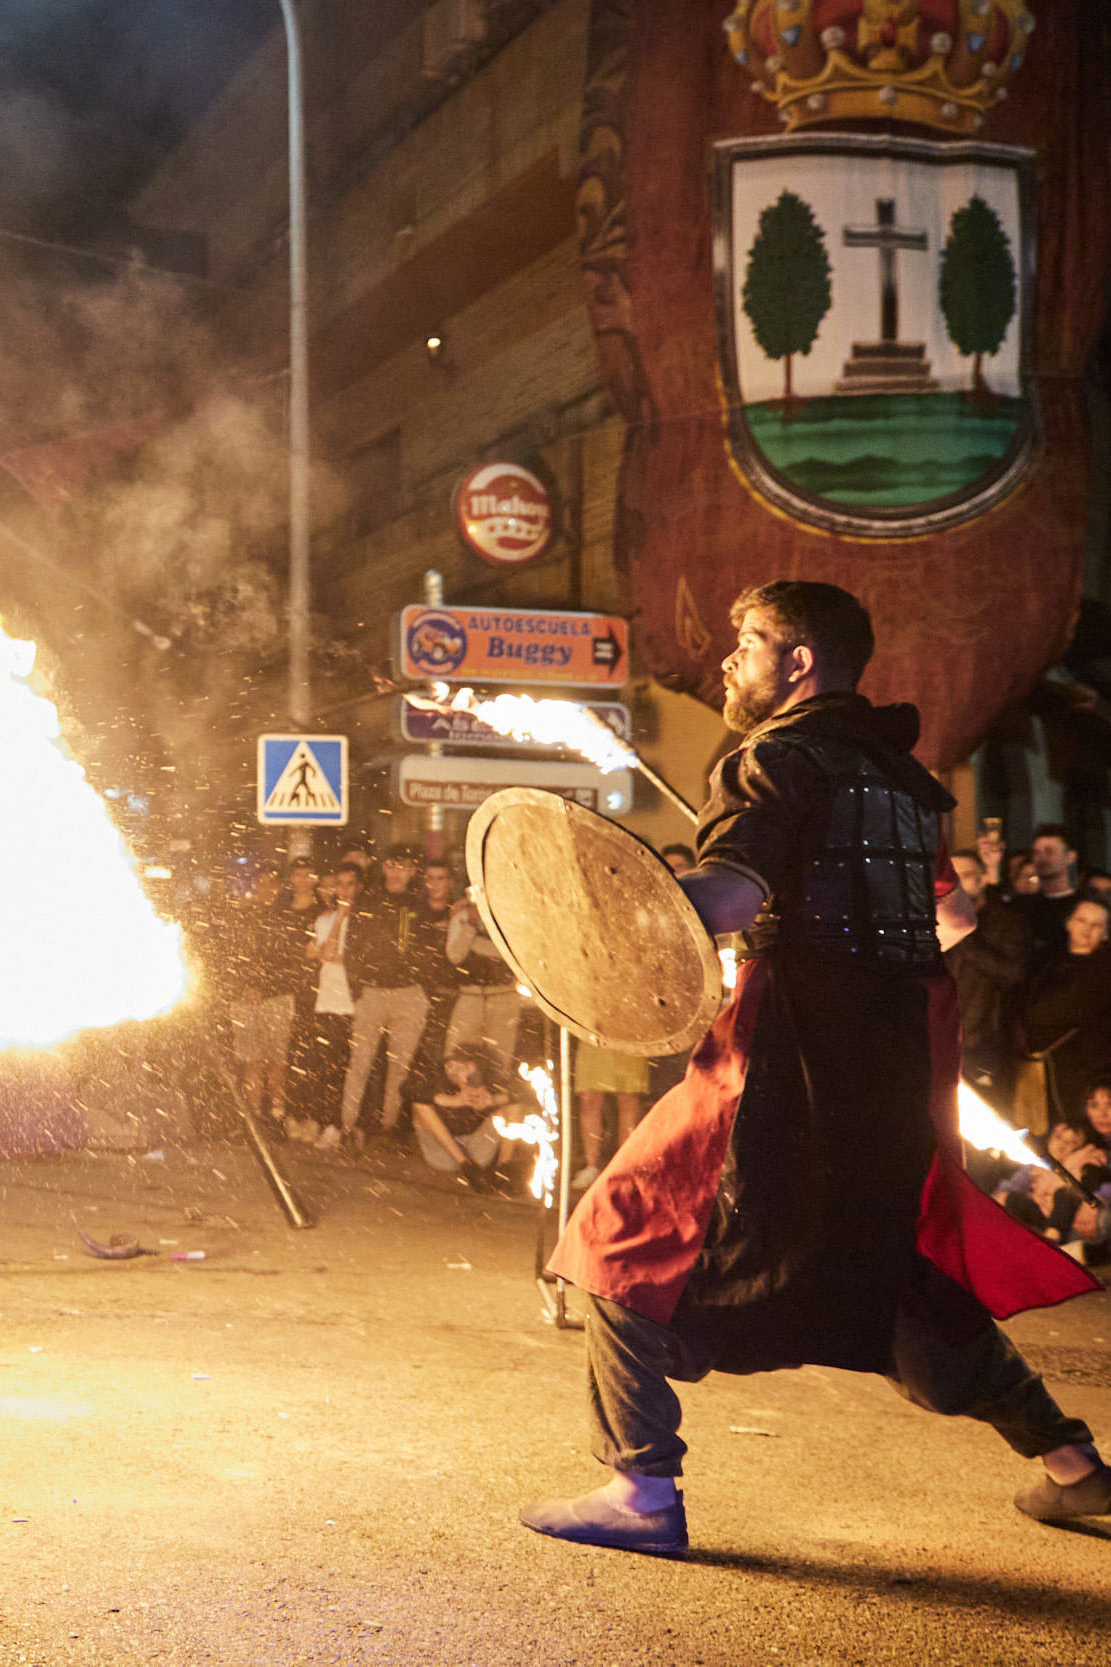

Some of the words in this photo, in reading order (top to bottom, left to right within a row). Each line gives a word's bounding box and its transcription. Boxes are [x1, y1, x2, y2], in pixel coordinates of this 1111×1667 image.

[469, 616, 591, 636] AUTOESCUELA
[486, 636, 573, 666] Buggy
[409, 783, 441, 800] Plaza
[443, 785, 458, 802] de
